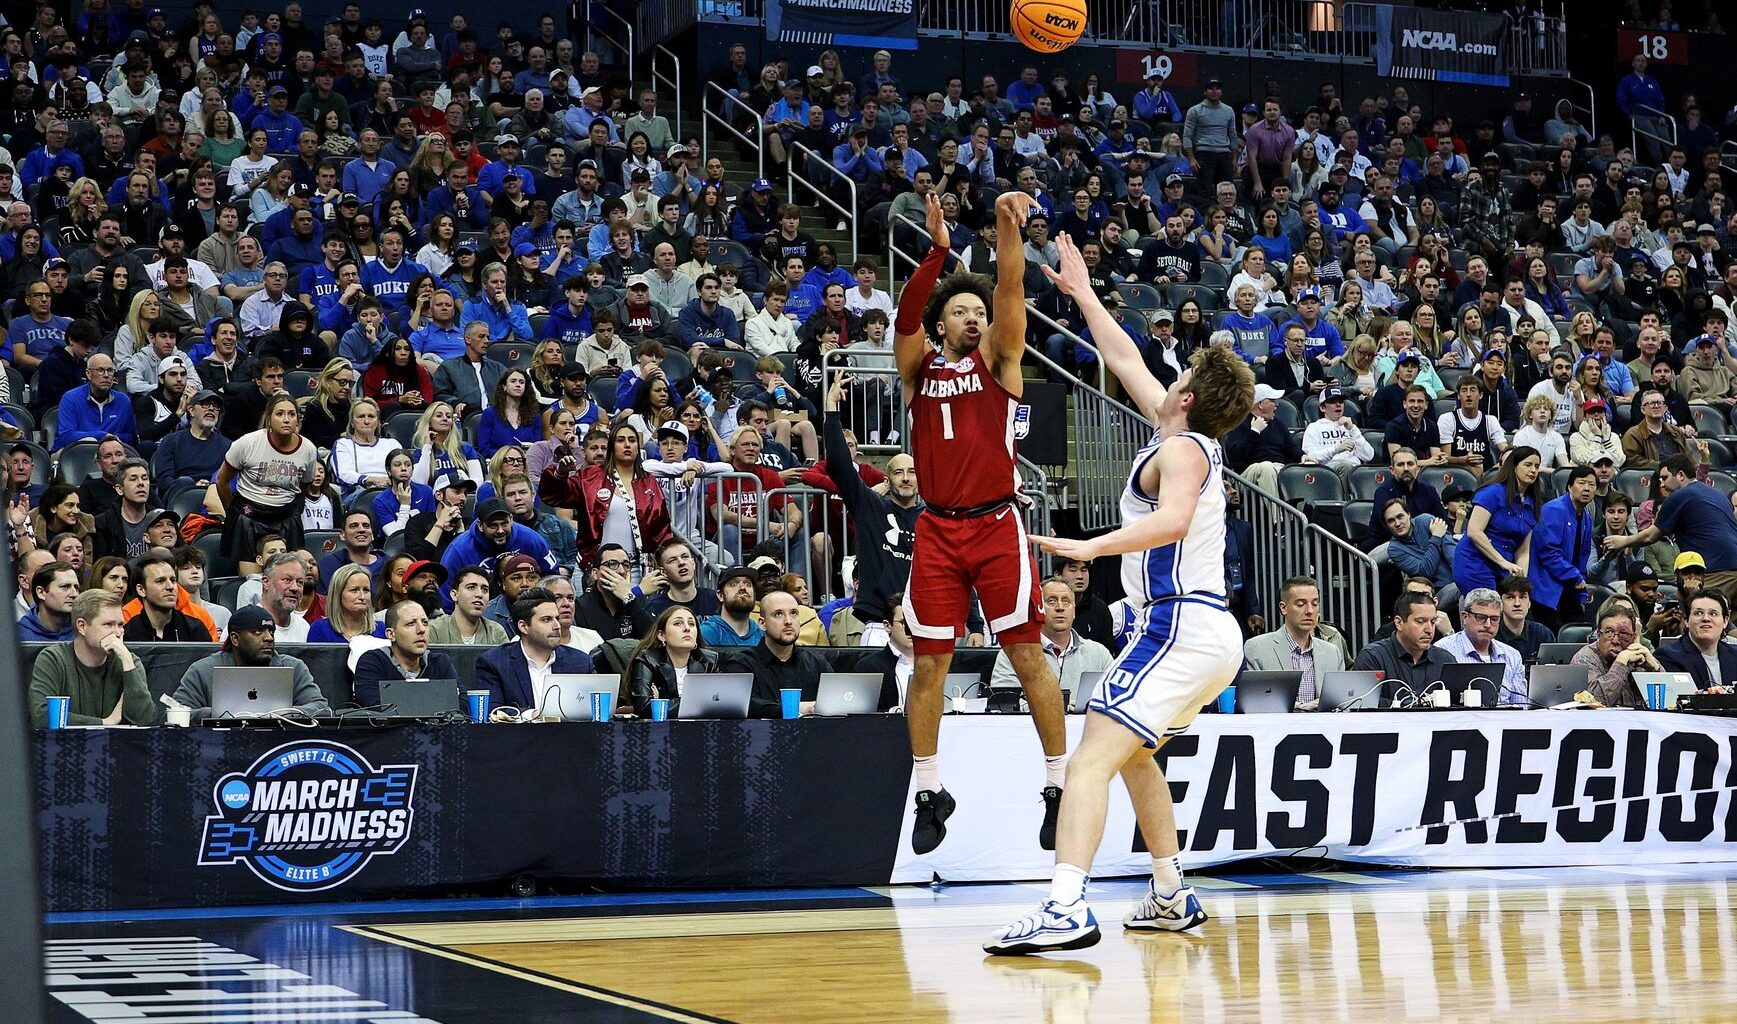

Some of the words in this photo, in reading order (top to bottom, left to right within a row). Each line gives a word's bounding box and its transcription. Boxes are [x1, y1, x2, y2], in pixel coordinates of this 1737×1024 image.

[1045, 12, 1079, 31] NCAA
[1402, 29, 1498, 57] NCAA.com
[1638, 35, 1668, 60] 18
[1140, 54, 1173, 80] 19
[1157, 256, 1178, 268] SETON
[1240, 331, 1265, 341] DUKE
[670, 422, 680, 430] D
[941, 402, 955, 440] 1
[1321, 430, 1350, 440] DUK
[1456, 436, 1486, 453] Duke
[302, 508, 332, 520] DUKE
[1109, 668, 1134, 689] D
[280, 752, 319, 766] SWEET
[321, 752, 334, 763] 16
[224, 792, 249, 803] NCAA
[251, 778, 359, 811] MARCH
[1131, 732, 1399, 852] EAST
[1420, 727, 1737, 845] REGIO
[264, 809, 409, 844] MADNESS
[286, 867, 319, 881] ELITE
[321, 866, 330, 877] 8
